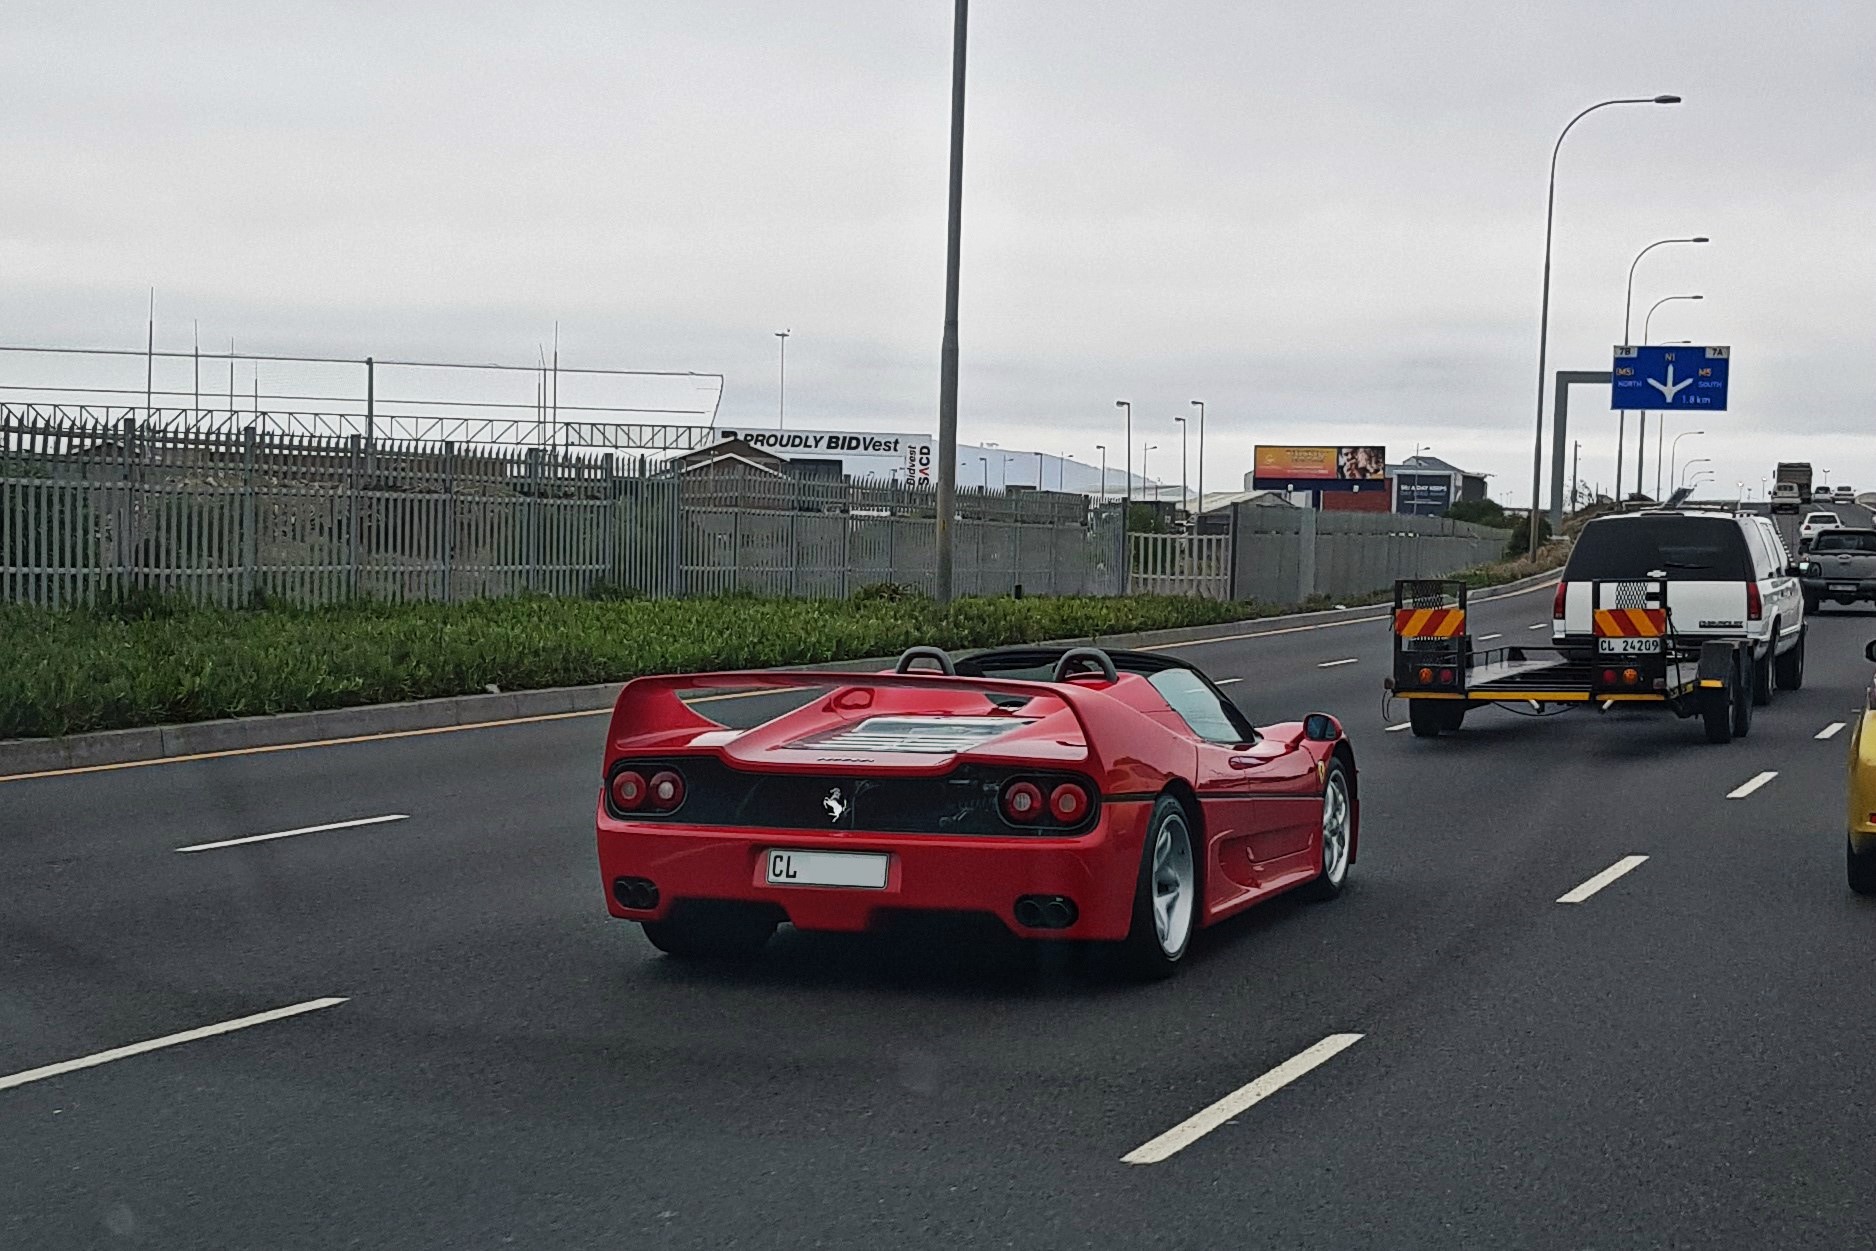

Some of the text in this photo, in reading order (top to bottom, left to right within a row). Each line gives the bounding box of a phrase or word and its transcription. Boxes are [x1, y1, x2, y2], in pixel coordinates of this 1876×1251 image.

[1619, 347, 1631, 355] 7B
[1712, 348, 1723, 356] 7A
[1665, 353, 1676, 361] N1
[1617, 380, 1642, 388] NORTH
[1696, 395, 1711, 404] km
[743, 433, 900, 452] PROUDLY BIDVest
[1600, 639, 1660, 652] CL 24209
[772, 854, 798, 879] CL
